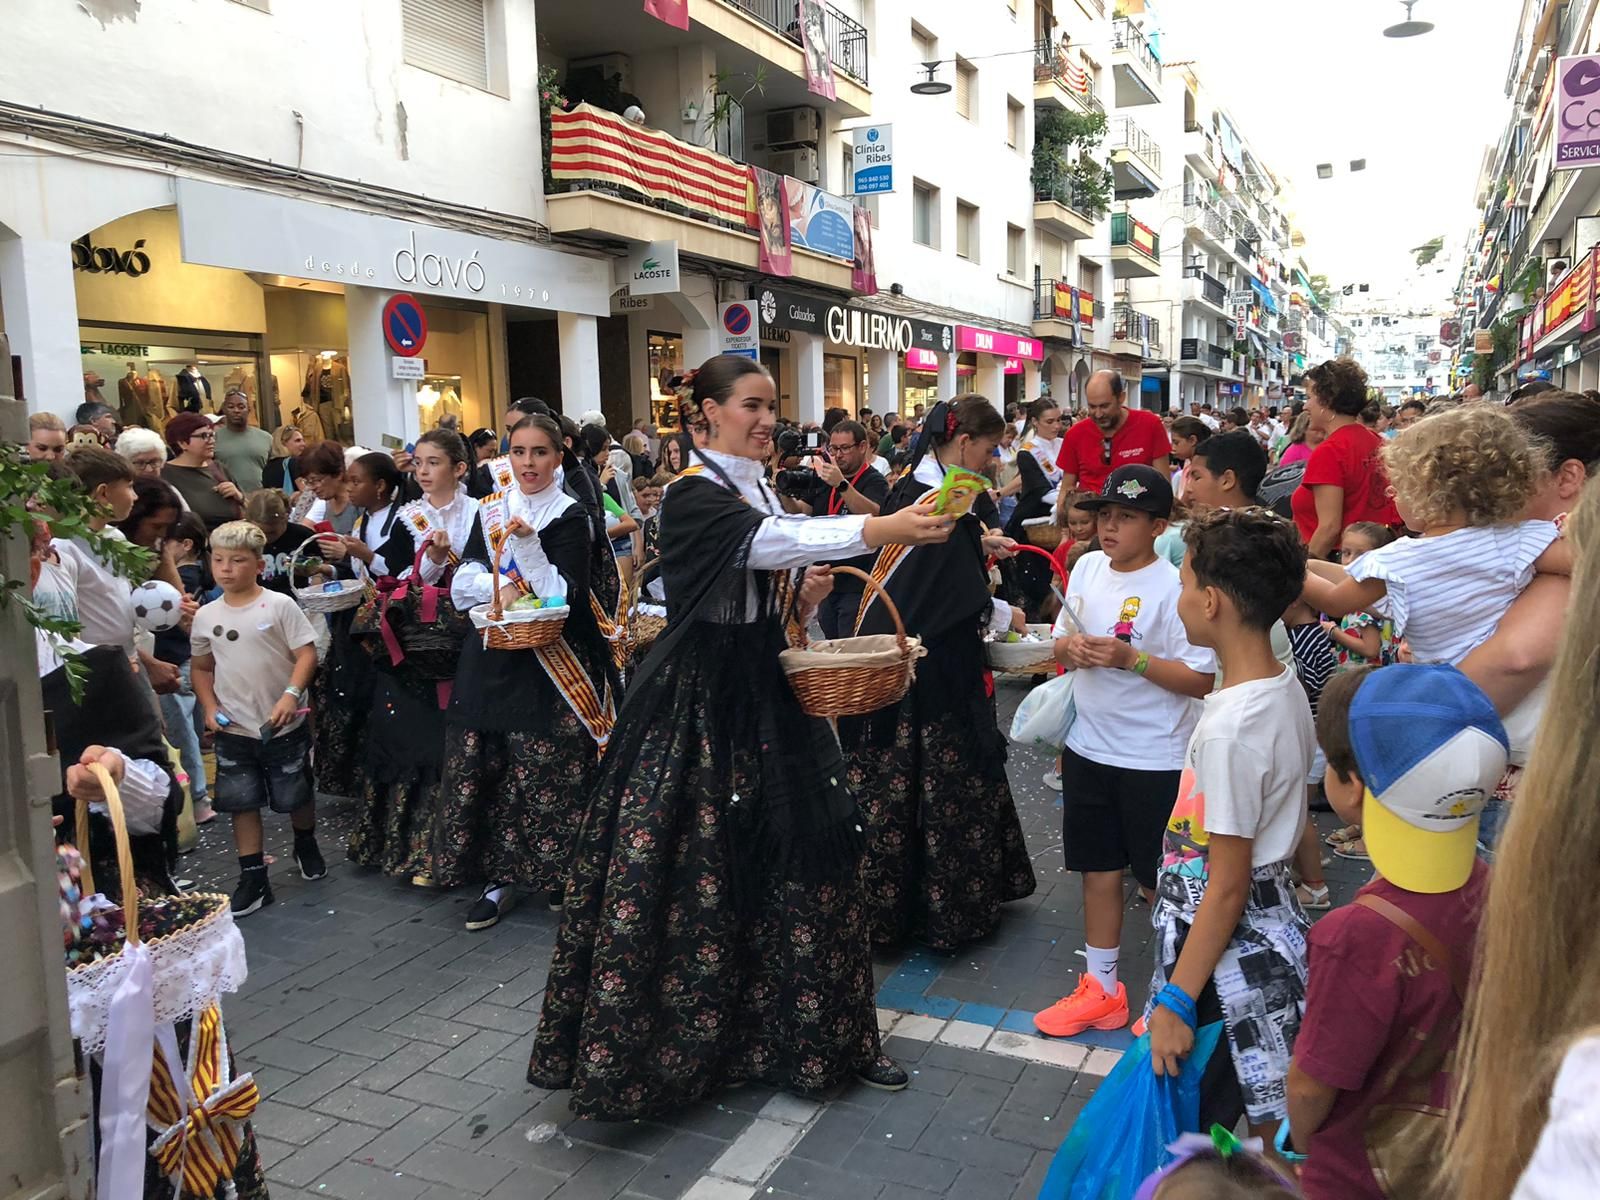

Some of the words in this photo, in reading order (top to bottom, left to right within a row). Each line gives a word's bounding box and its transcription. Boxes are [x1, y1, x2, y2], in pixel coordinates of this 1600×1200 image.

[855, 144, 885, 155] Clínica
[866, 153, 892, 164] Ribes
[304, 255, 375, 280] desde
[393, 230, 486, 293] davó
[501, 283, 549, 302] 1970
[634, 269, 671, 280] LACOSTE
[620, 297, 648, 309] Ribes
[826, 306, 913, 353] GUILLERMO
[100, 343, 149, 357] LACOSTE
